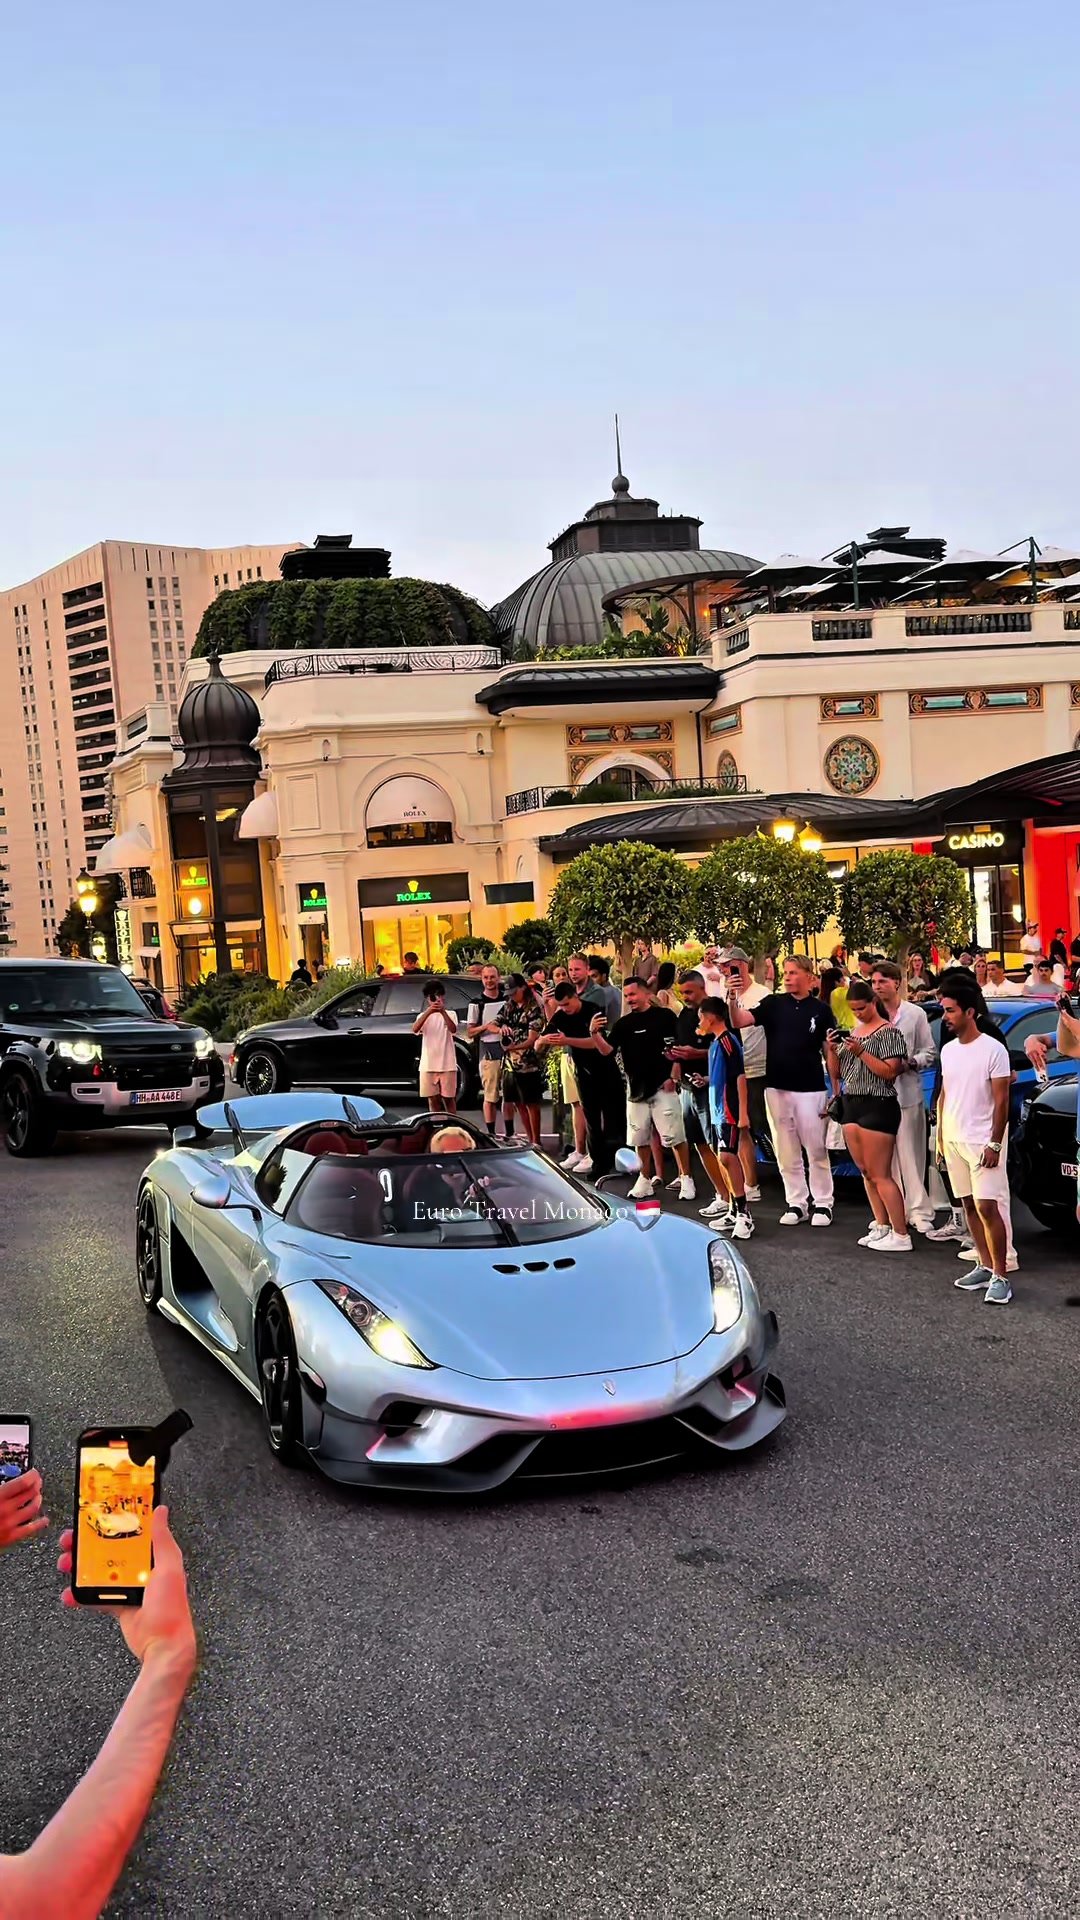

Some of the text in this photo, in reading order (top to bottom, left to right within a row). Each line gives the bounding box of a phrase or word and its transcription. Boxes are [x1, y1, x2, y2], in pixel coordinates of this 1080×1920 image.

[948, 832, 1005, 850] CASINO
[396, 892, 432, 902] ROLEX
[303, 898, 328, 907] ROLEX
